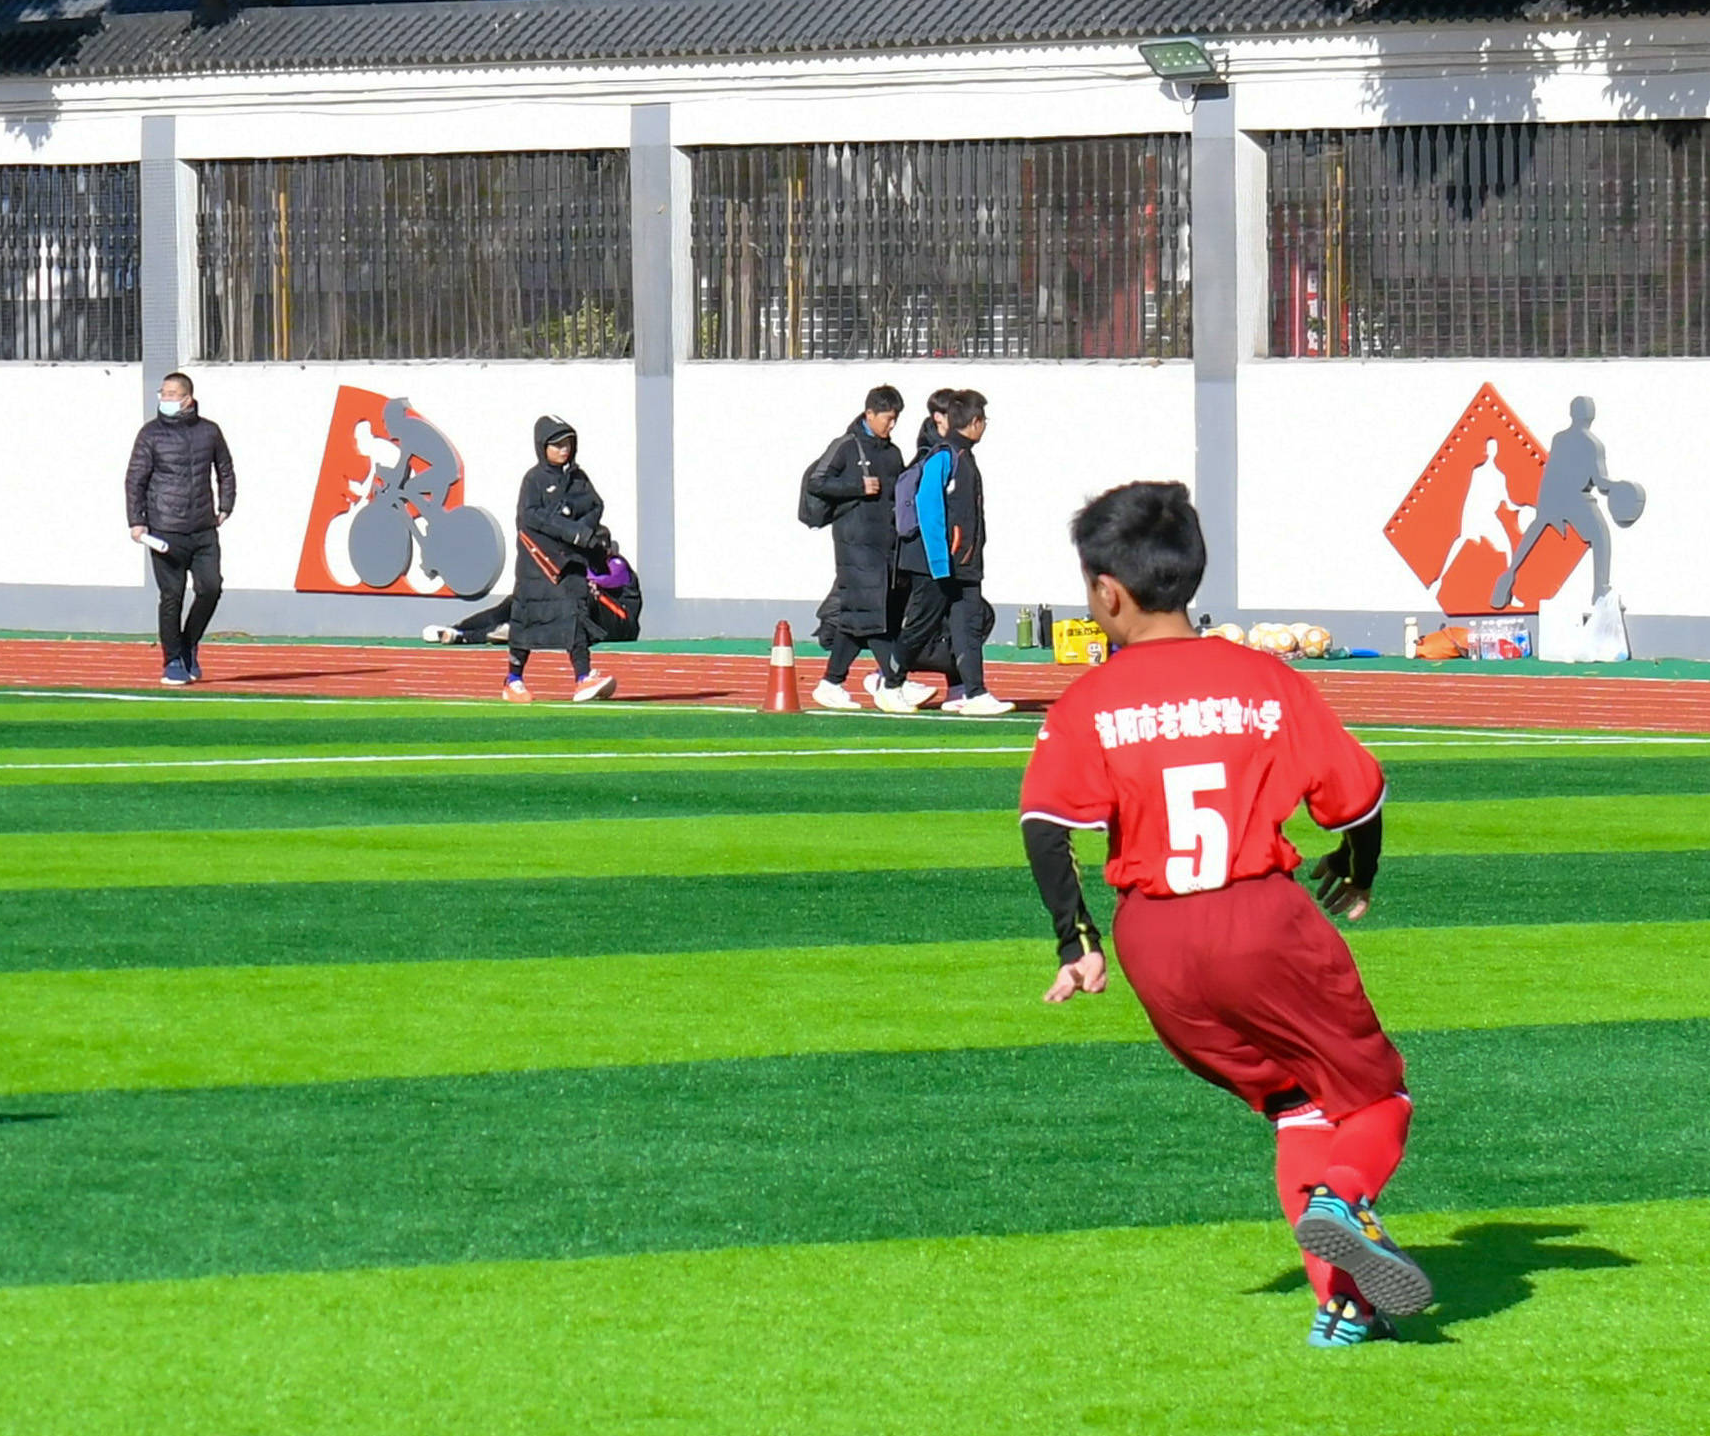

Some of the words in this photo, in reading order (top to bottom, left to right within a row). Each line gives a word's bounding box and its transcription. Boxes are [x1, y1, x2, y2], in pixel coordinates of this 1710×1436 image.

[1094, 696, 1282, 750] 洛阳市老城实验小学
[1162, 761, 1228, 895] 5
